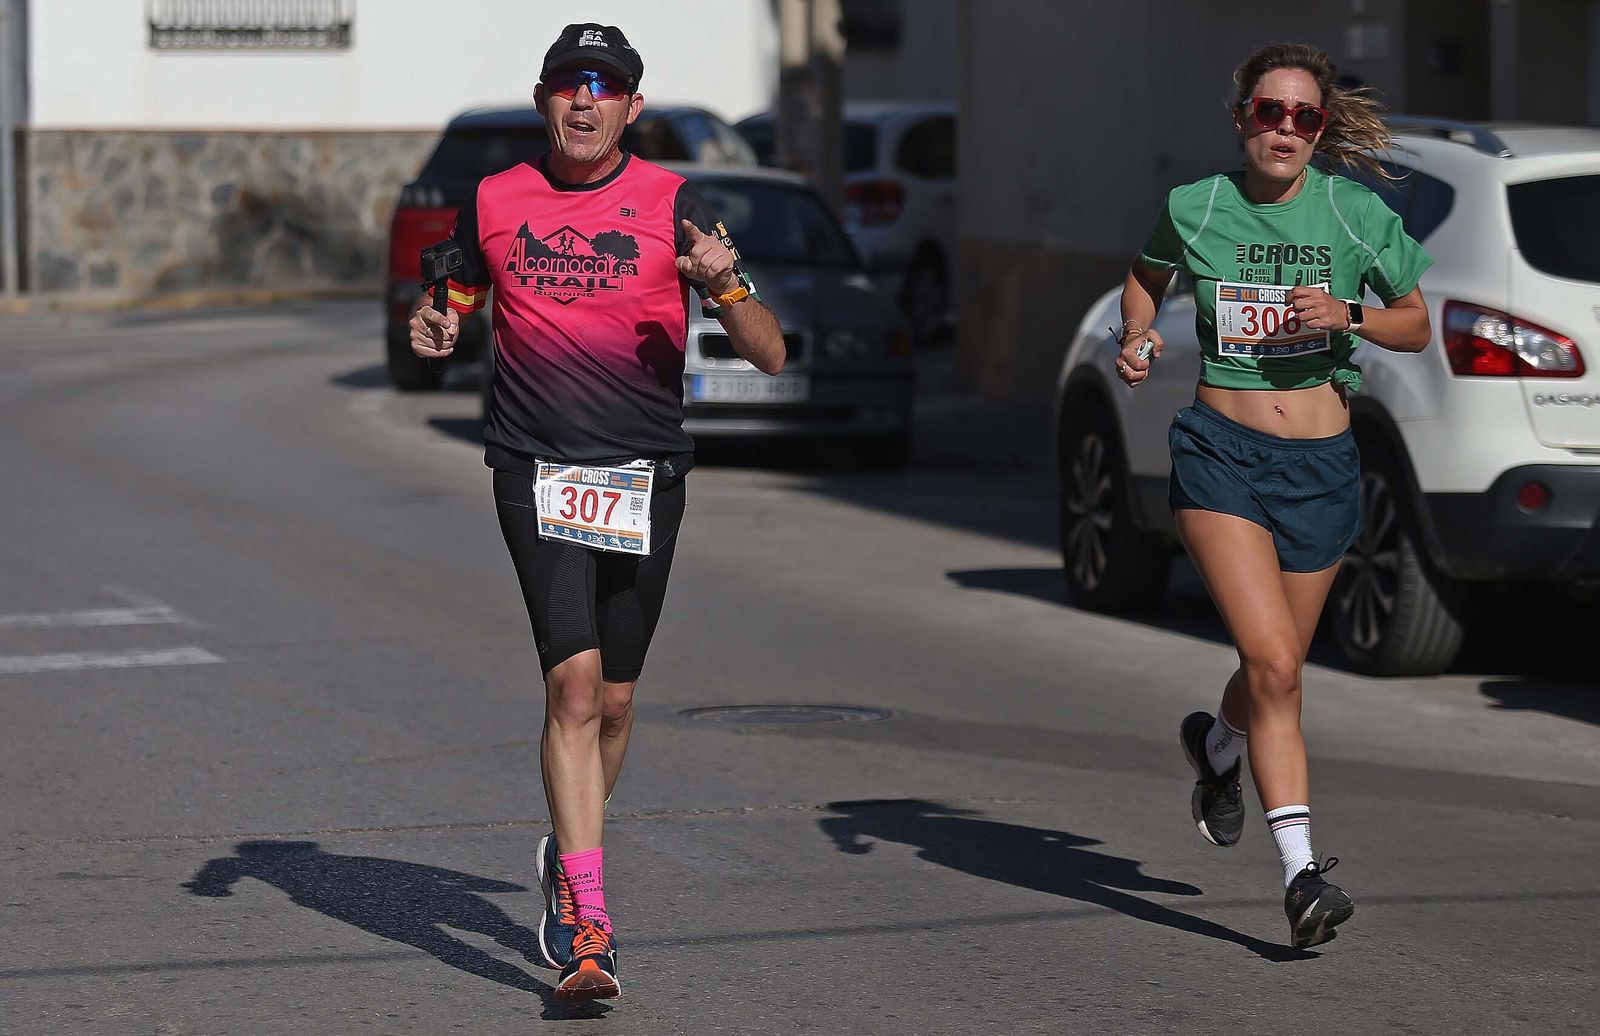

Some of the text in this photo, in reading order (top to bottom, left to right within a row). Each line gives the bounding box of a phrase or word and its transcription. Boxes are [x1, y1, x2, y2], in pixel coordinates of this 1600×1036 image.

[1236, 243, 1332, 267] XLII CROSS
[514, 275, 620, 290] TRAIL
[1239, 268, 1253, 281] 16
[1254, 275, 1270, 283] 2023
[1258, 288, 1286, 303] CROSS
[1241, 305, 1301, 337] 306
[581, 468, 610, 486] CROSS
[559, 486, 622, 526] 307
